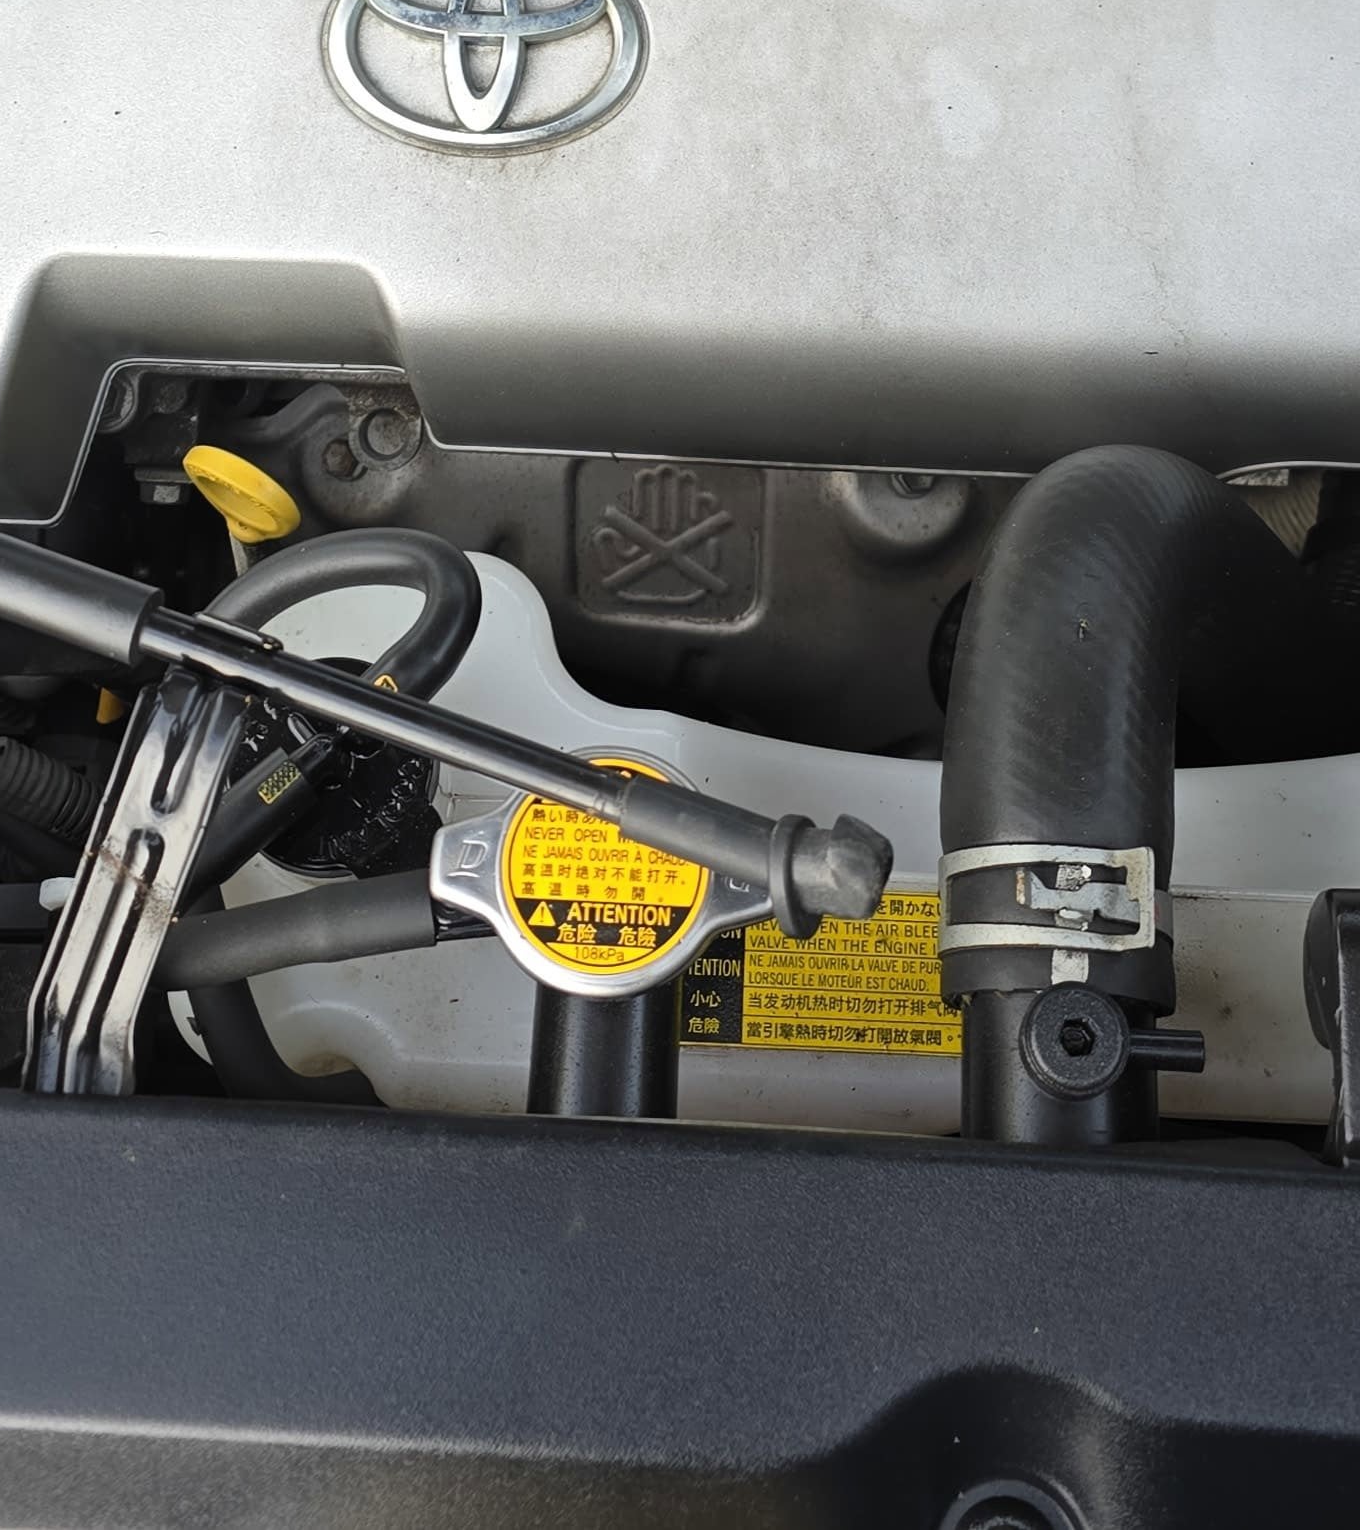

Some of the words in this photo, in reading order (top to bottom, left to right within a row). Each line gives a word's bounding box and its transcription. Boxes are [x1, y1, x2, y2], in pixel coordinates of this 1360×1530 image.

[525, 827, 565, 841] NEVER
[574, 829, 608, 843] OPEN
[523, 845, 538, 858] NE
[543, 846, 584, 861] JAMAIS
[590, 848, 629, 863] OUVRIR
[566, 902, 672, 927] ATTENTION
[844, 922, 871, 936] THE
[876, 924, 898, 937] AIR
[574, 946, 625, 962] 108kPa
[749, 936, 789, 950] VALVE
[795, 937, 836, 951] WHEN
[842, 940, 869, 953] THE
[875, 941, 931, 955] ENGINE
[749, 954, 764, 967] NE
[766, 955, 805, 969] JAMAIS
[808, 957, 848, 970] OUVRIR
[851, 958, 865, 971] LA
[868, 959, 898, 973] VALVE
[902, 961, 917, 973] DE
[749, 972, 798, 986] LORSQUE
[802, 974, 815, 987] LE
[818, 975, 862, 989] MOTEUR
[866, 977, 887, 990] EST
[690, 990, 721, 1008] 小心
[688, 1017, 720, 1034] 危險
